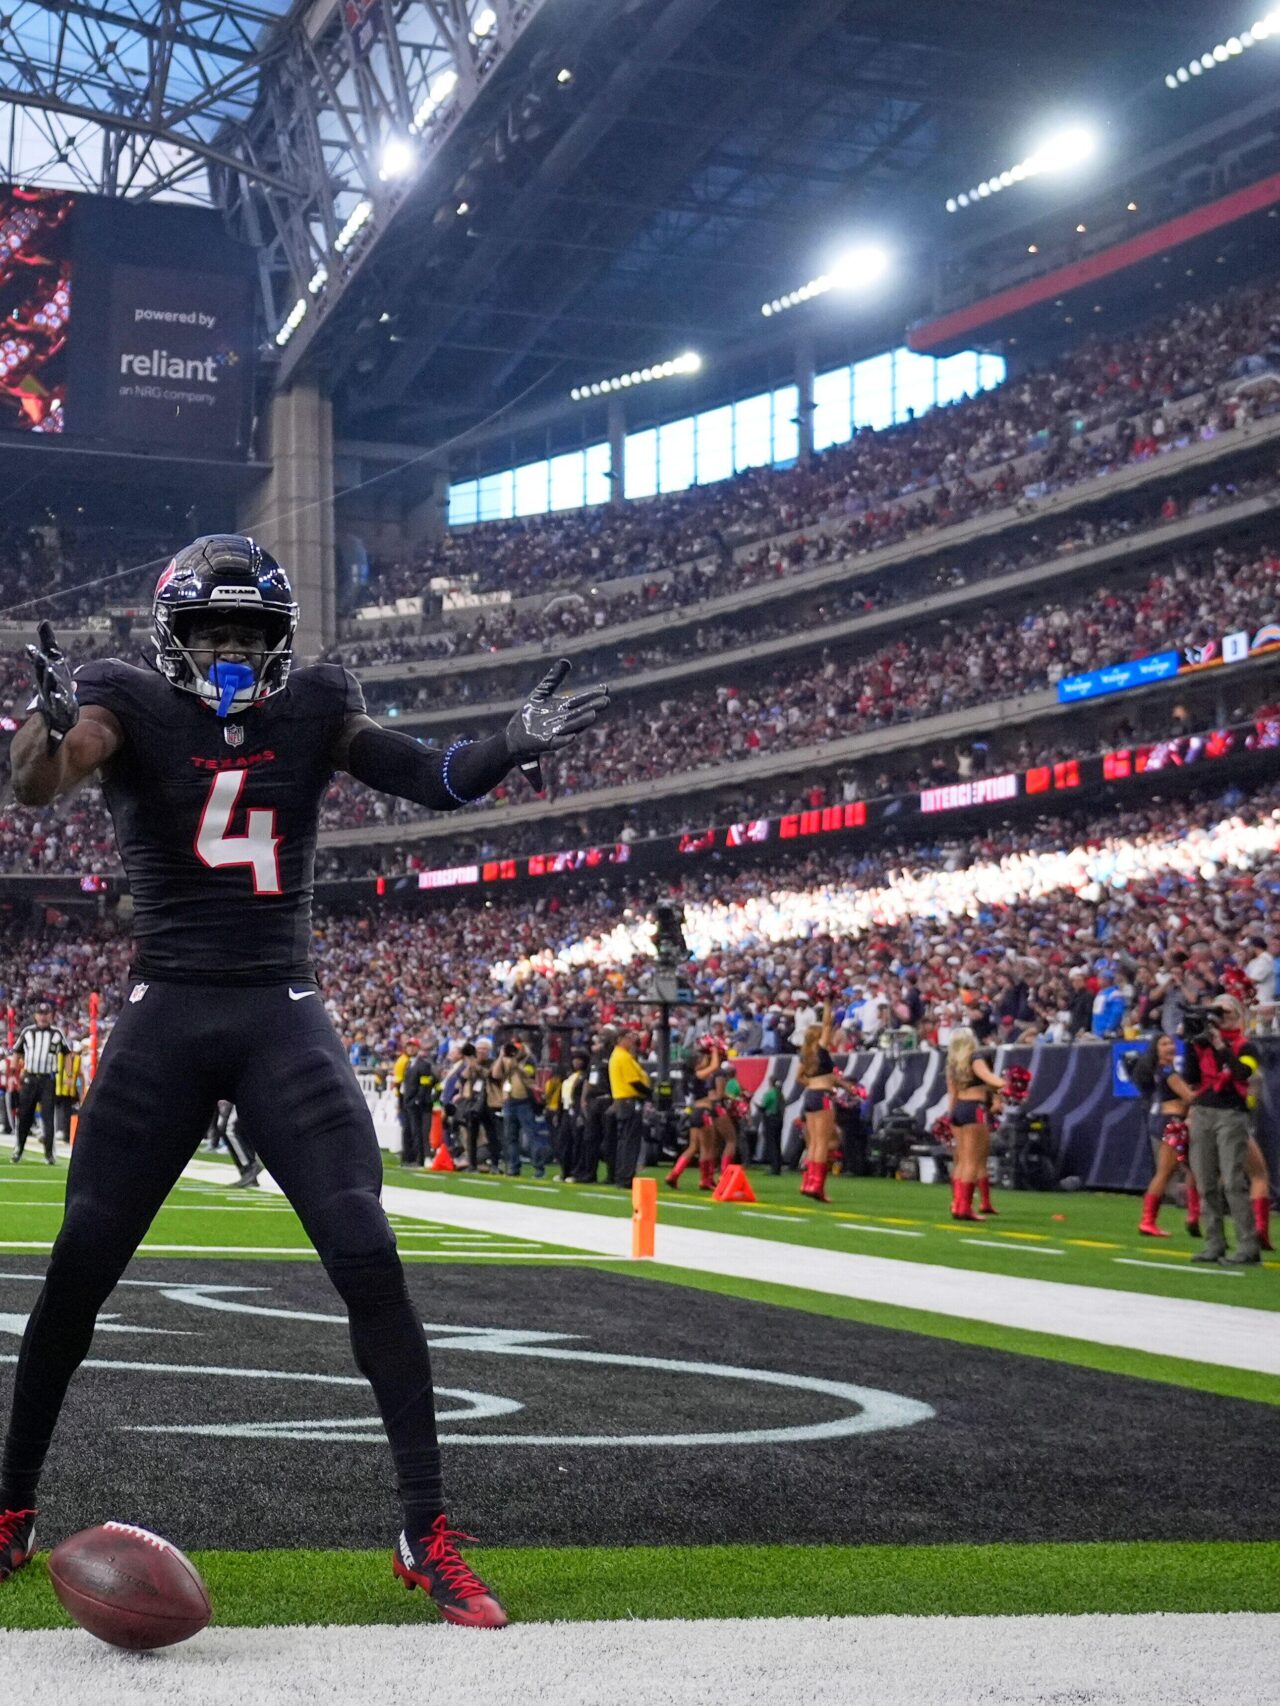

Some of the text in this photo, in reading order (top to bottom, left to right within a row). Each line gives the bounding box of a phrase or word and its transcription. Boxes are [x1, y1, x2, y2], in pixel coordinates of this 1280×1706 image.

[134, 308, 216, 329] powered by
[120, 349, 218, 383] reliant
[119, 385, 216, 406] an NRG company
[218, 588, 257, 596] TEXANS
[191, 750, 276, 770] TEXANS
[193, 768, 285, 896] 4
